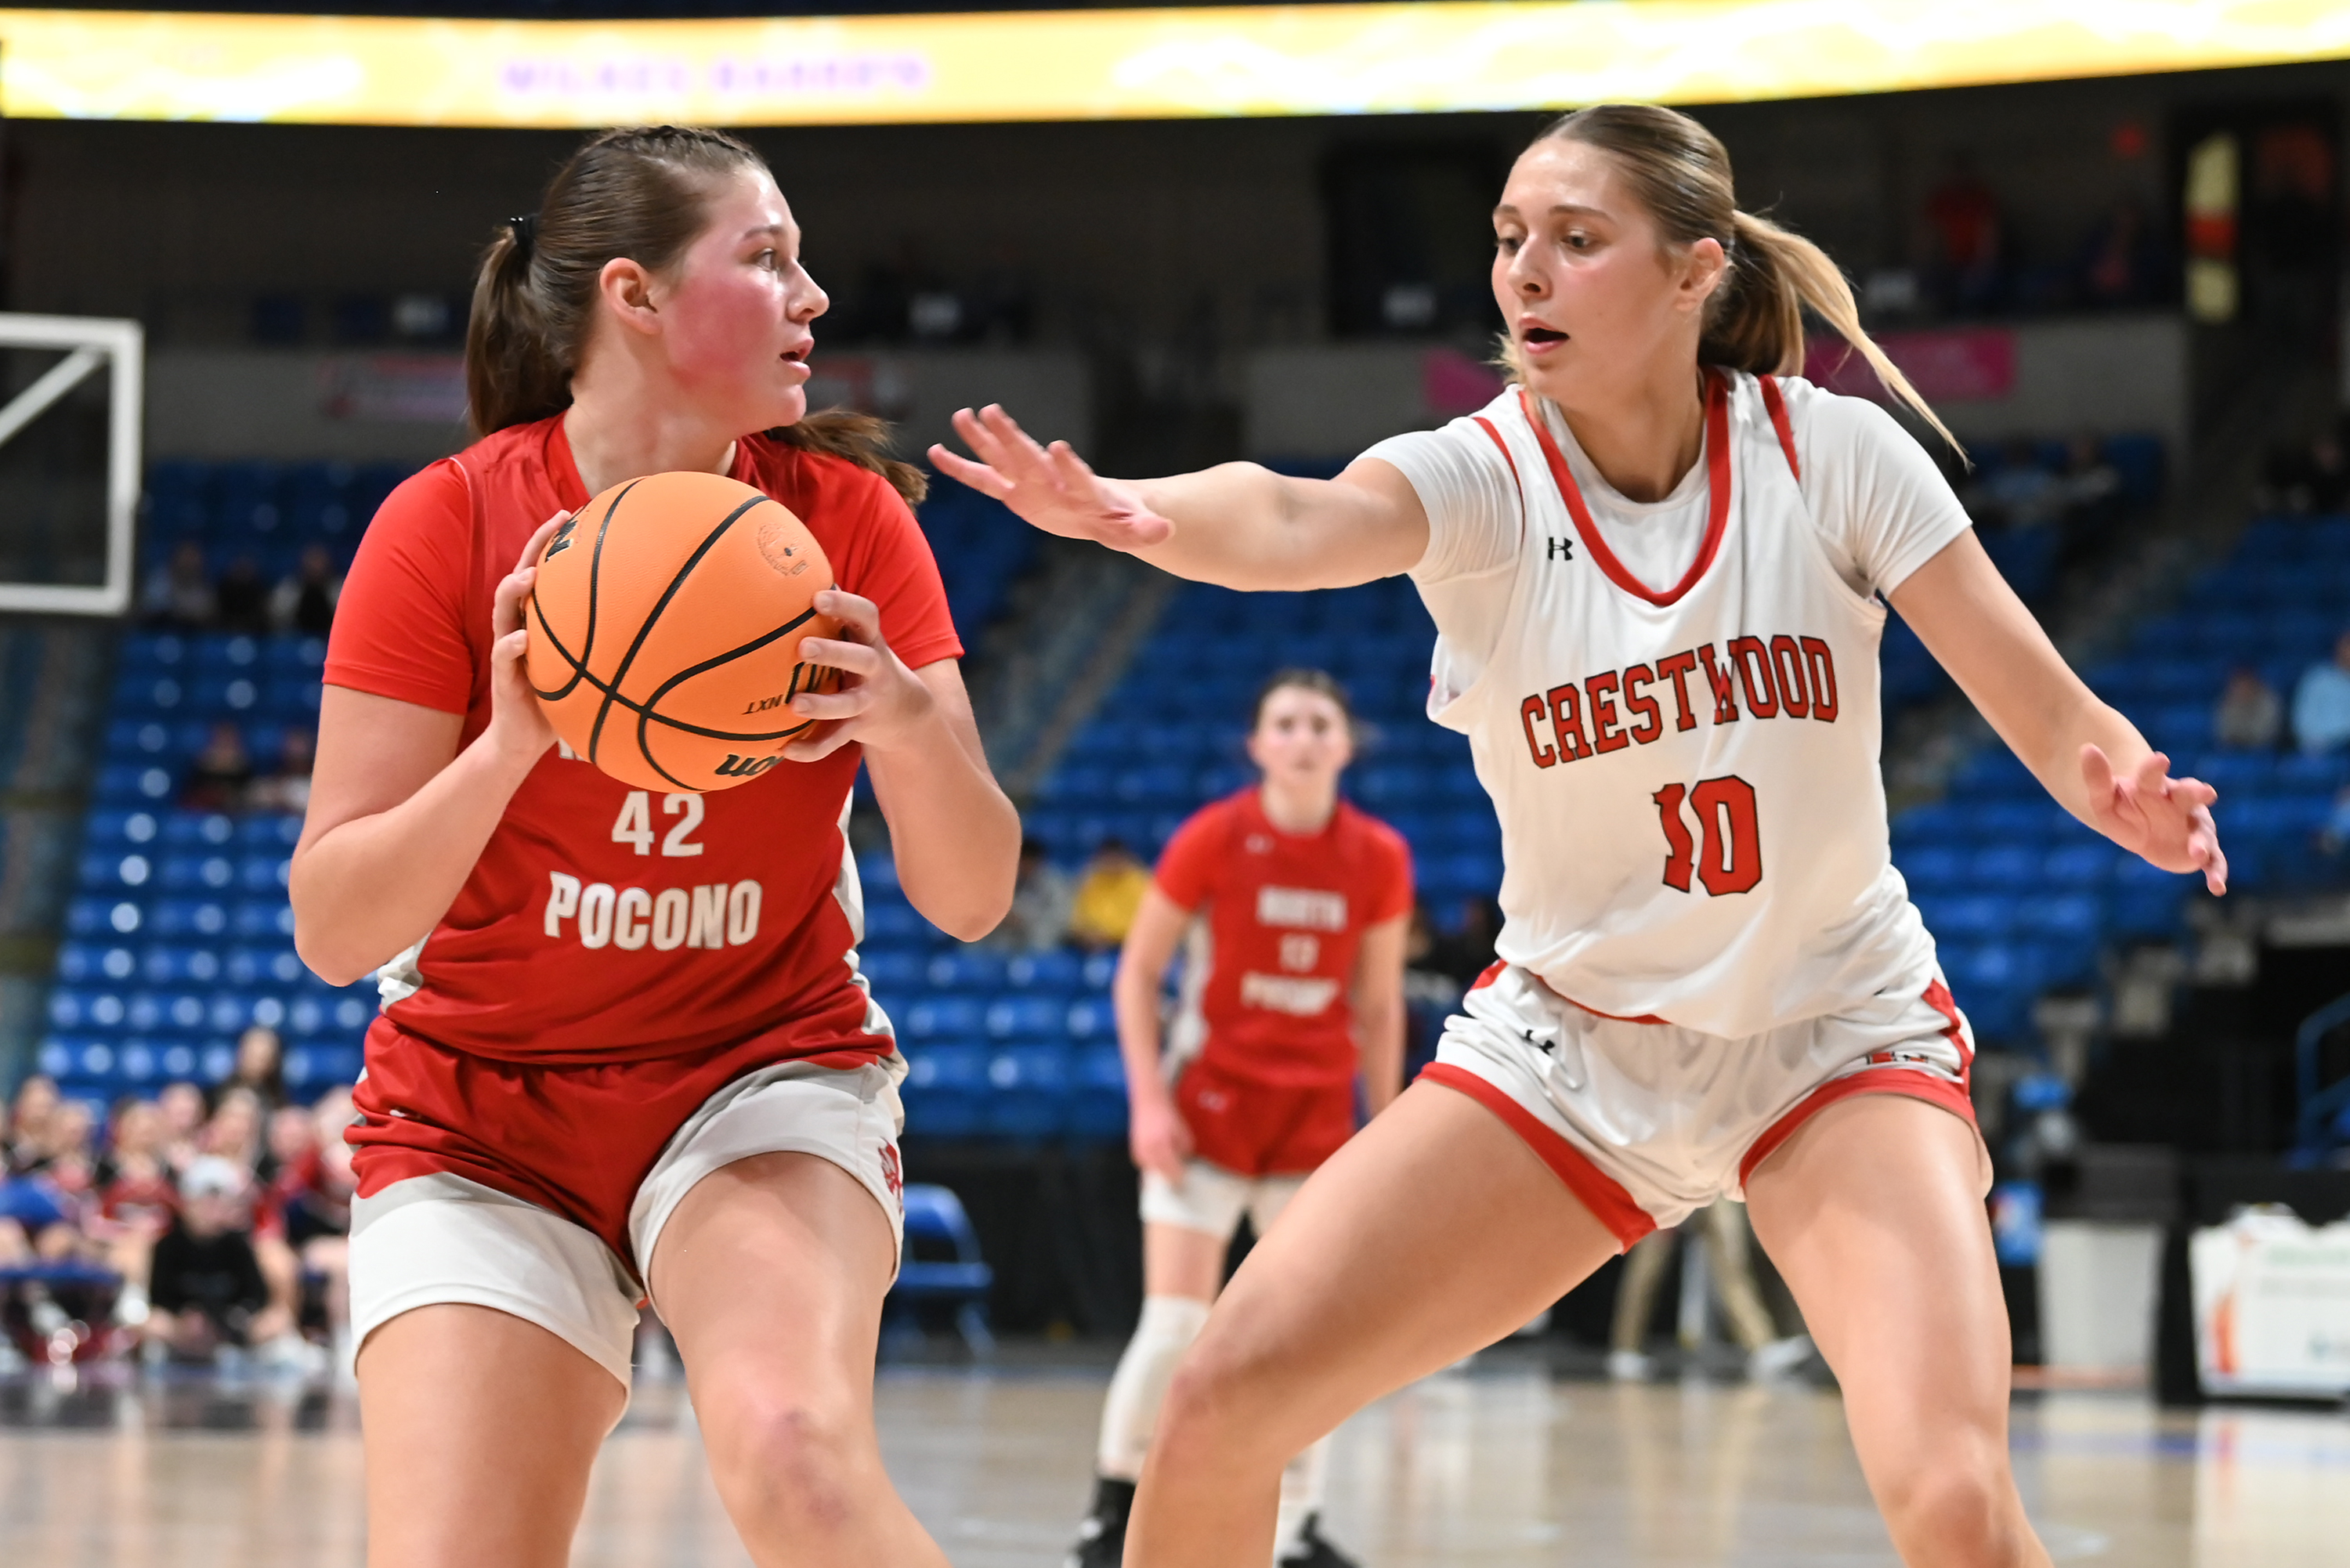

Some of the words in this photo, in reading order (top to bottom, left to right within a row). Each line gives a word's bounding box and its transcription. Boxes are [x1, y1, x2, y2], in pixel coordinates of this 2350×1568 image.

[742, 693, 783, 714] NXT
[1520, 634, 1838, 768] CRESTWOOD
[612, 790, 704, 857] 42
[1652, 775, 1762, 897] 10
[544, 871, 762, 951] POCONO
